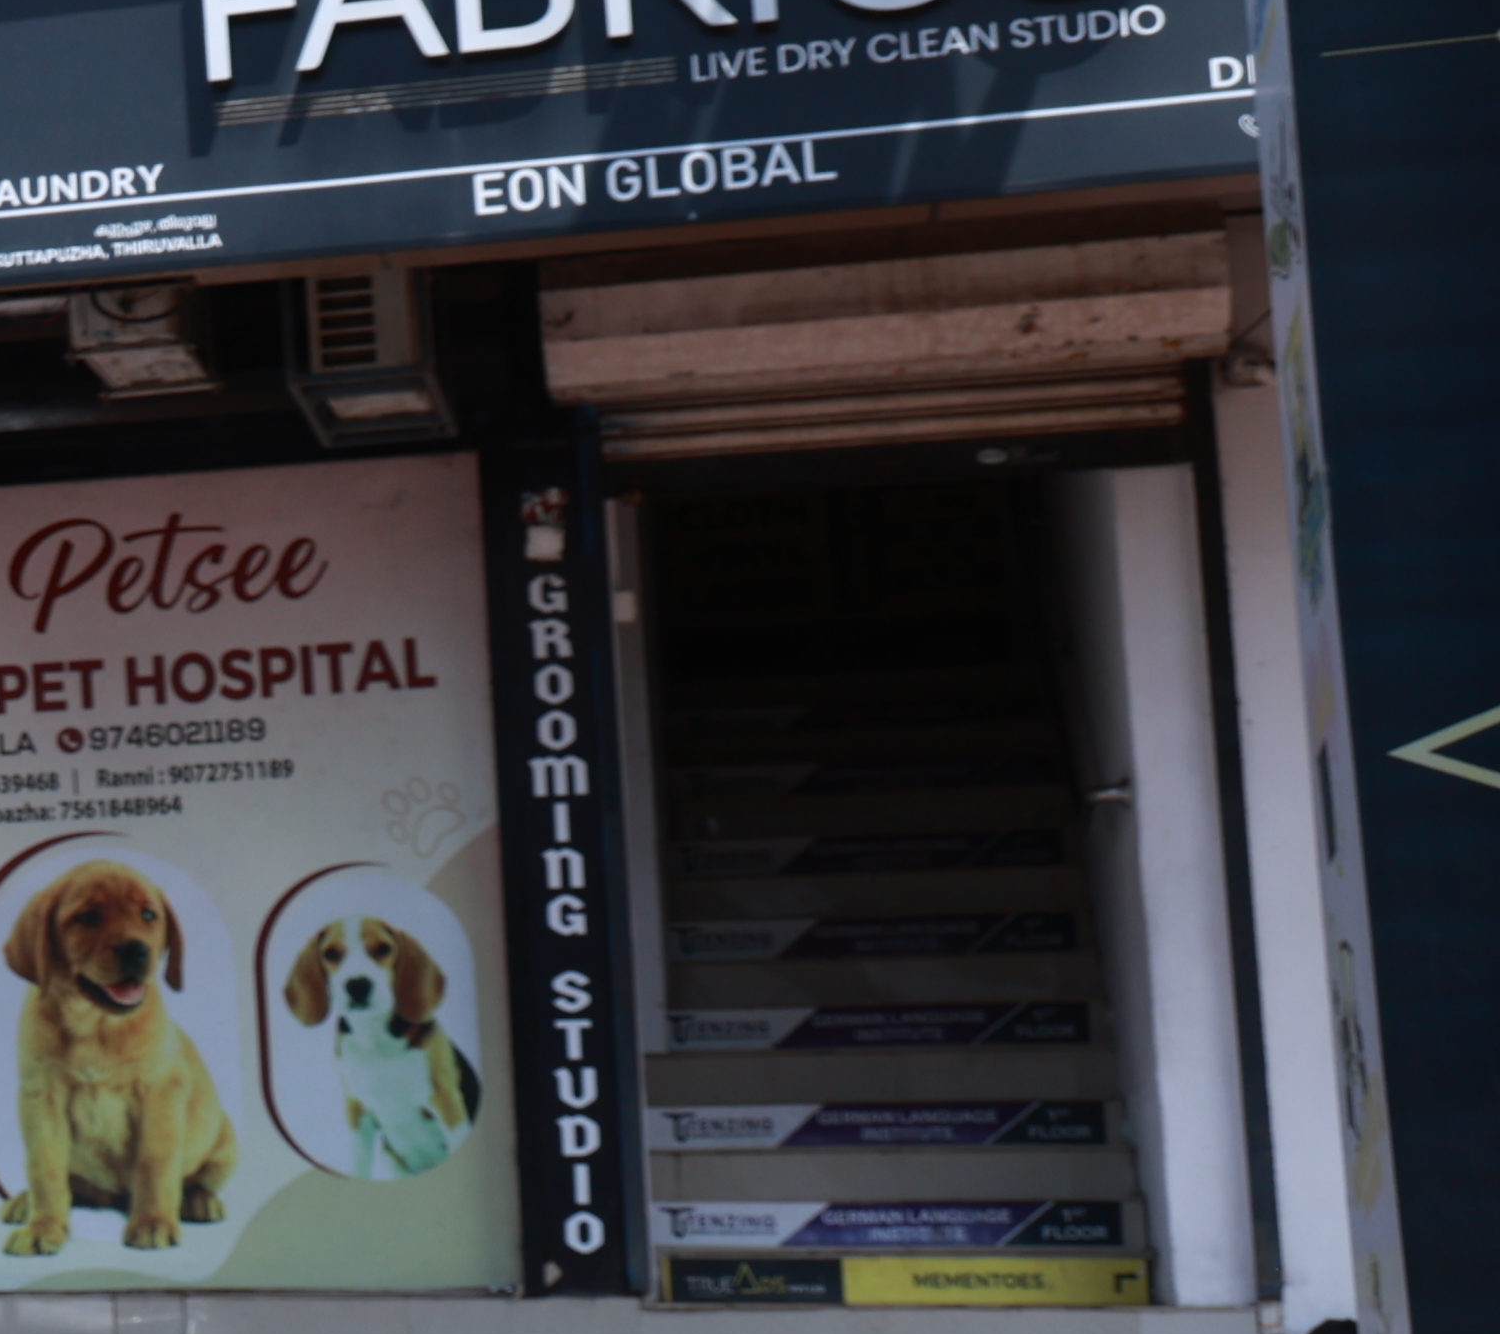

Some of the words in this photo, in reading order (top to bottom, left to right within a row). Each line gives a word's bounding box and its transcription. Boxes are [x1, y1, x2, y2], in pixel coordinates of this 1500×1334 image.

[690, 45, 769, 83] LIVE
[776, 35, 857, 76] DRY
[866, 19, 1000, 66] CLEAN
[1008, 3, 1167, 51] STUDIO
[472, 163, 590, 218] EON
[606, 139, 838, 204] GLOBAL
[112, 232, 223, 258] THIRUVALLA
[8, 512, 329, 634] Petsee
[125, 637, 438, 709] HOSPITAL
[87, 716, 267, 752] 9746021189
[526, 572, 591, 938] GROOMING
[550, 968, 605, 1256] STUDIO
